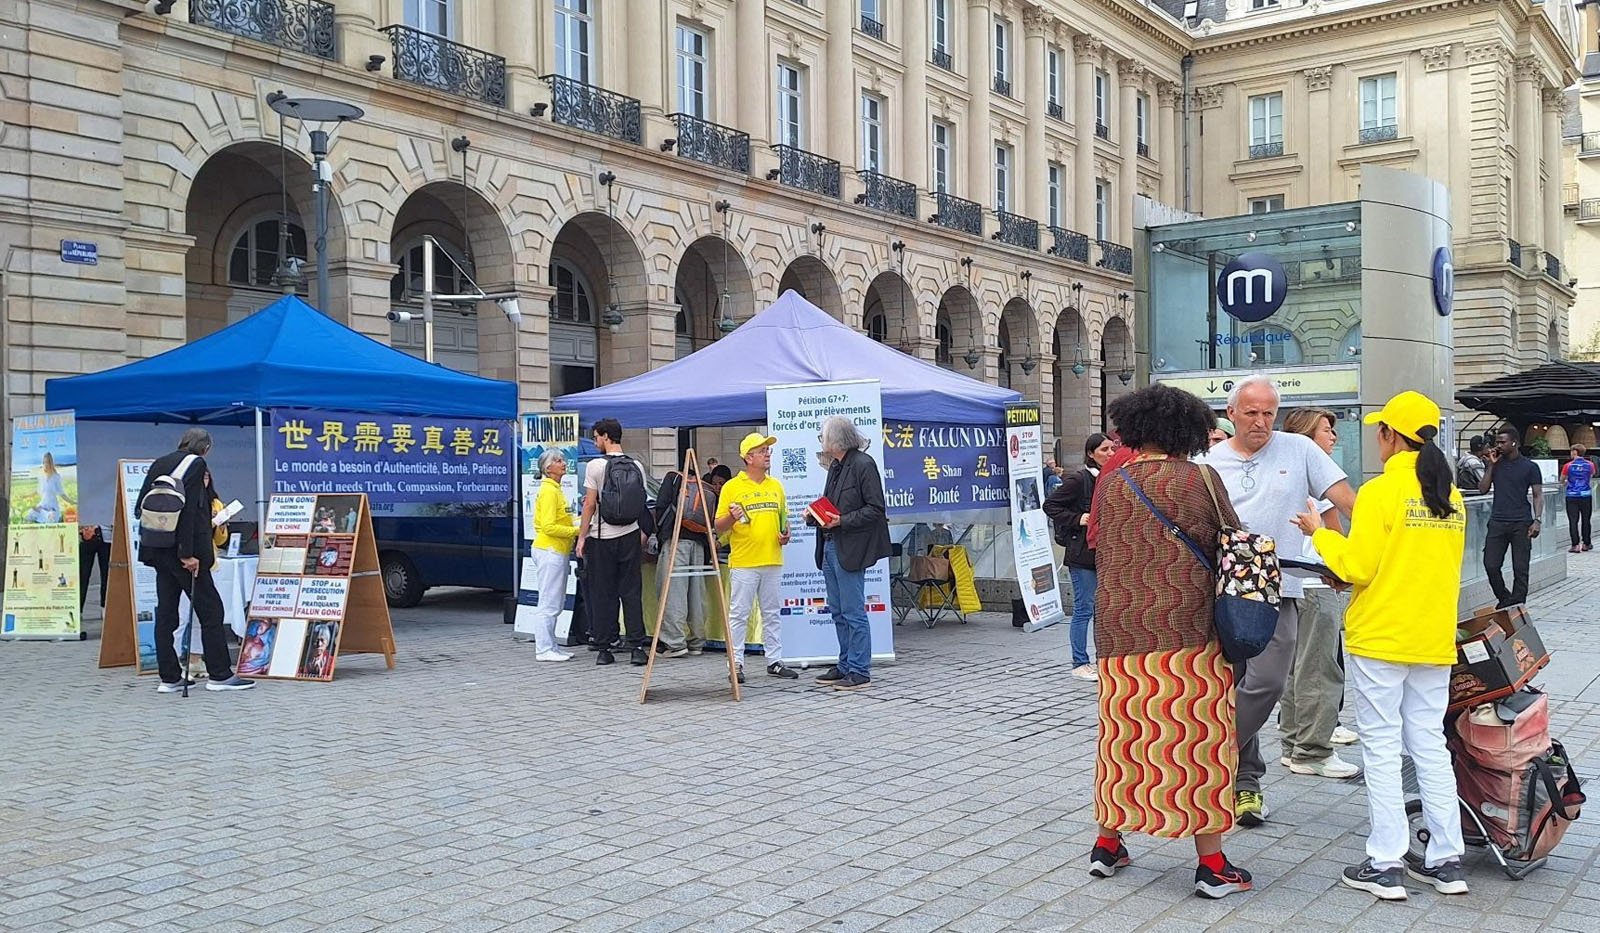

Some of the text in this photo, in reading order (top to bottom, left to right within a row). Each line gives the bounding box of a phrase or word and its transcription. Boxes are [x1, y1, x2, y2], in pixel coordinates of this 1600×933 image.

[798, 396, 827, 405] Pétition
[778, 405, 871, 420] Stop aux prélèvements
[1007, 406, 1038, 424] PÉTITION
[527, 416, 575, 442] FALUN DAFA
[773, 416, 878, 433] forcés d'org Chine
[279, 419, 503, 456] 世界需要真善忍
[919, 427, 971, 448] FALUN
[126, 465, 149, 475] LE G
[275, 459, 507, 476] Le monde a besoin d'Authenticité, Bonté, Patience
[923, 456, 941, 480] 善
[942, 464, 962, 478] Shan
[990, 464, 1005, 477] Ren
[274, 480, 508, 495] The World needs Truth, Compassion, Forbearance
[929, 485, 960, 505] Bonté
[886, 486, 915, 507] ticité
[256, 578, 300, 586] FALUN GONG
[297, 608, 320, 616] FALUN
